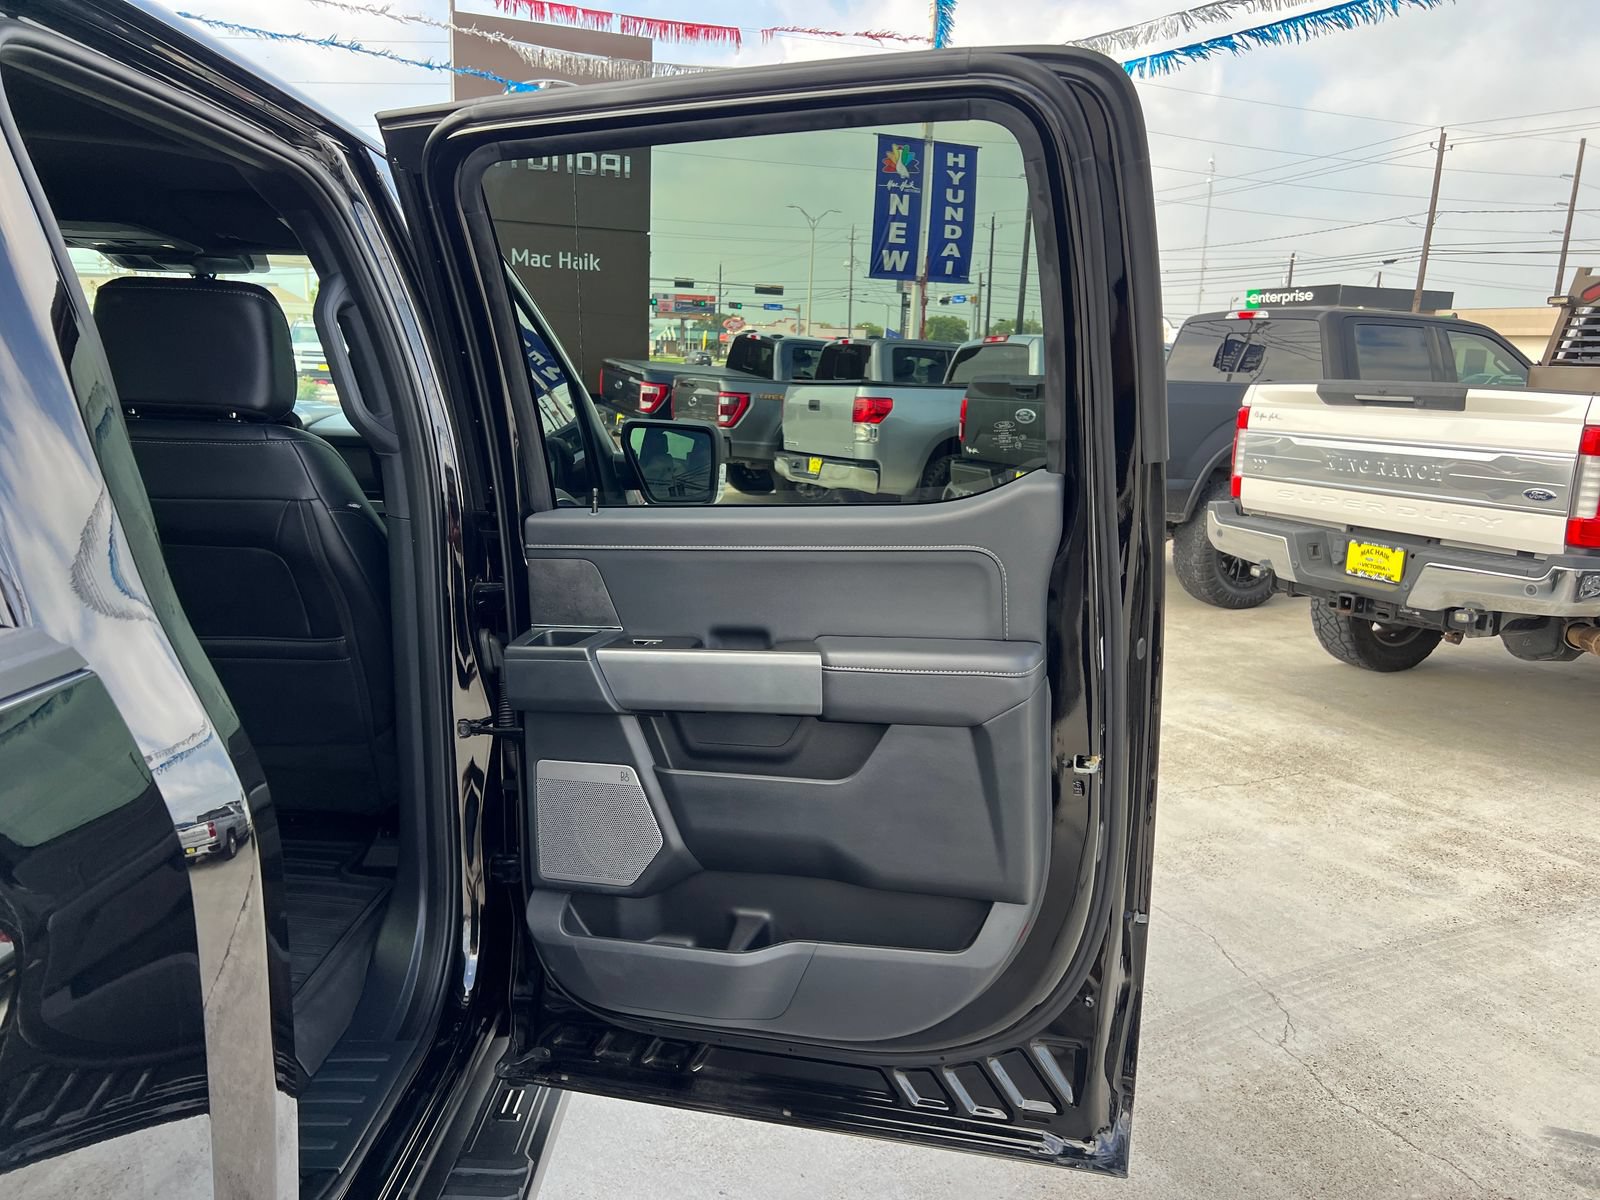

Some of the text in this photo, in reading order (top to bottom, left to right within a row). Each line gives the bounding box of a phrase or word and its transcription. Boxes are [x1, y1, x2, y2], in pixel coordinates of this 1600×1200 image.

[941, 152, 966, 275] HYUNDAI
[882, 193, 909, 272] NEW
[511, 248, 600, 272] Mac Haik
[1247, 289, 1314, 306] enterprise
[1325, 455, 1443, 482] KING RANCH
[1276, 489, 1504, 529] SUPER DUTY
